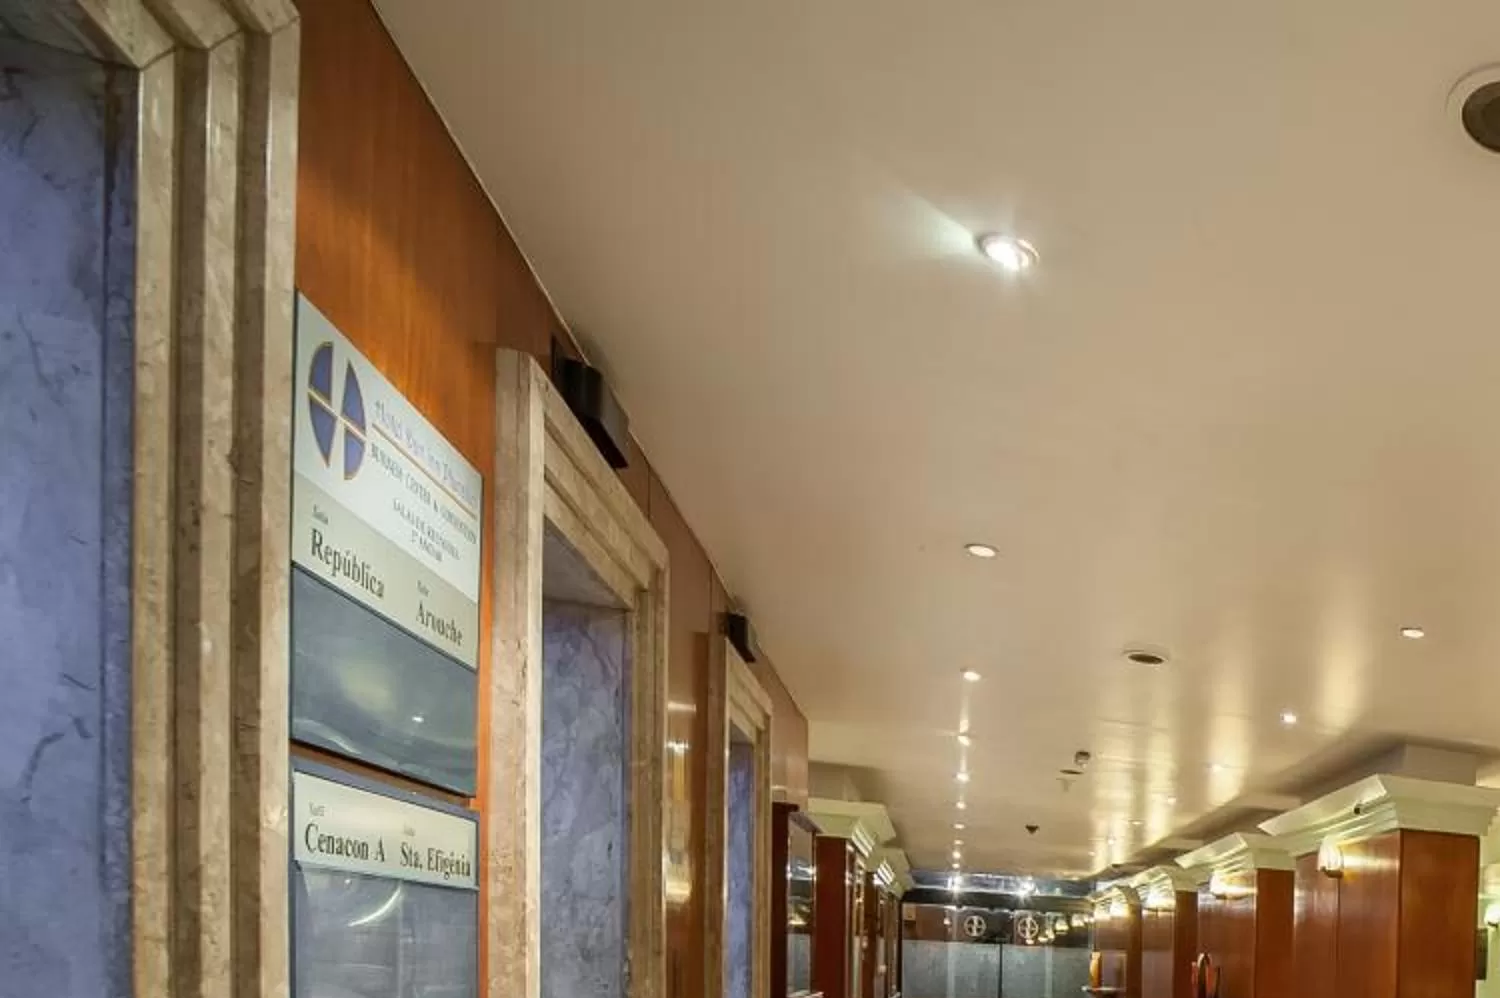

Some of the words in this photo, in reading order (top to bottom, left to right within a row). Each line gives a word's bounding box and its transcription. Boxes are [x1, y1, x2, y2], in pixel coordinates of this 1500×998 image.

[310, 527, 385, 599] República
[416, 600, 463, 647] Arouche
[304, 822, 369, 861] Cenacon
[373, 836, 386, 863] A
[400, 841, 423, 871] Sta.
